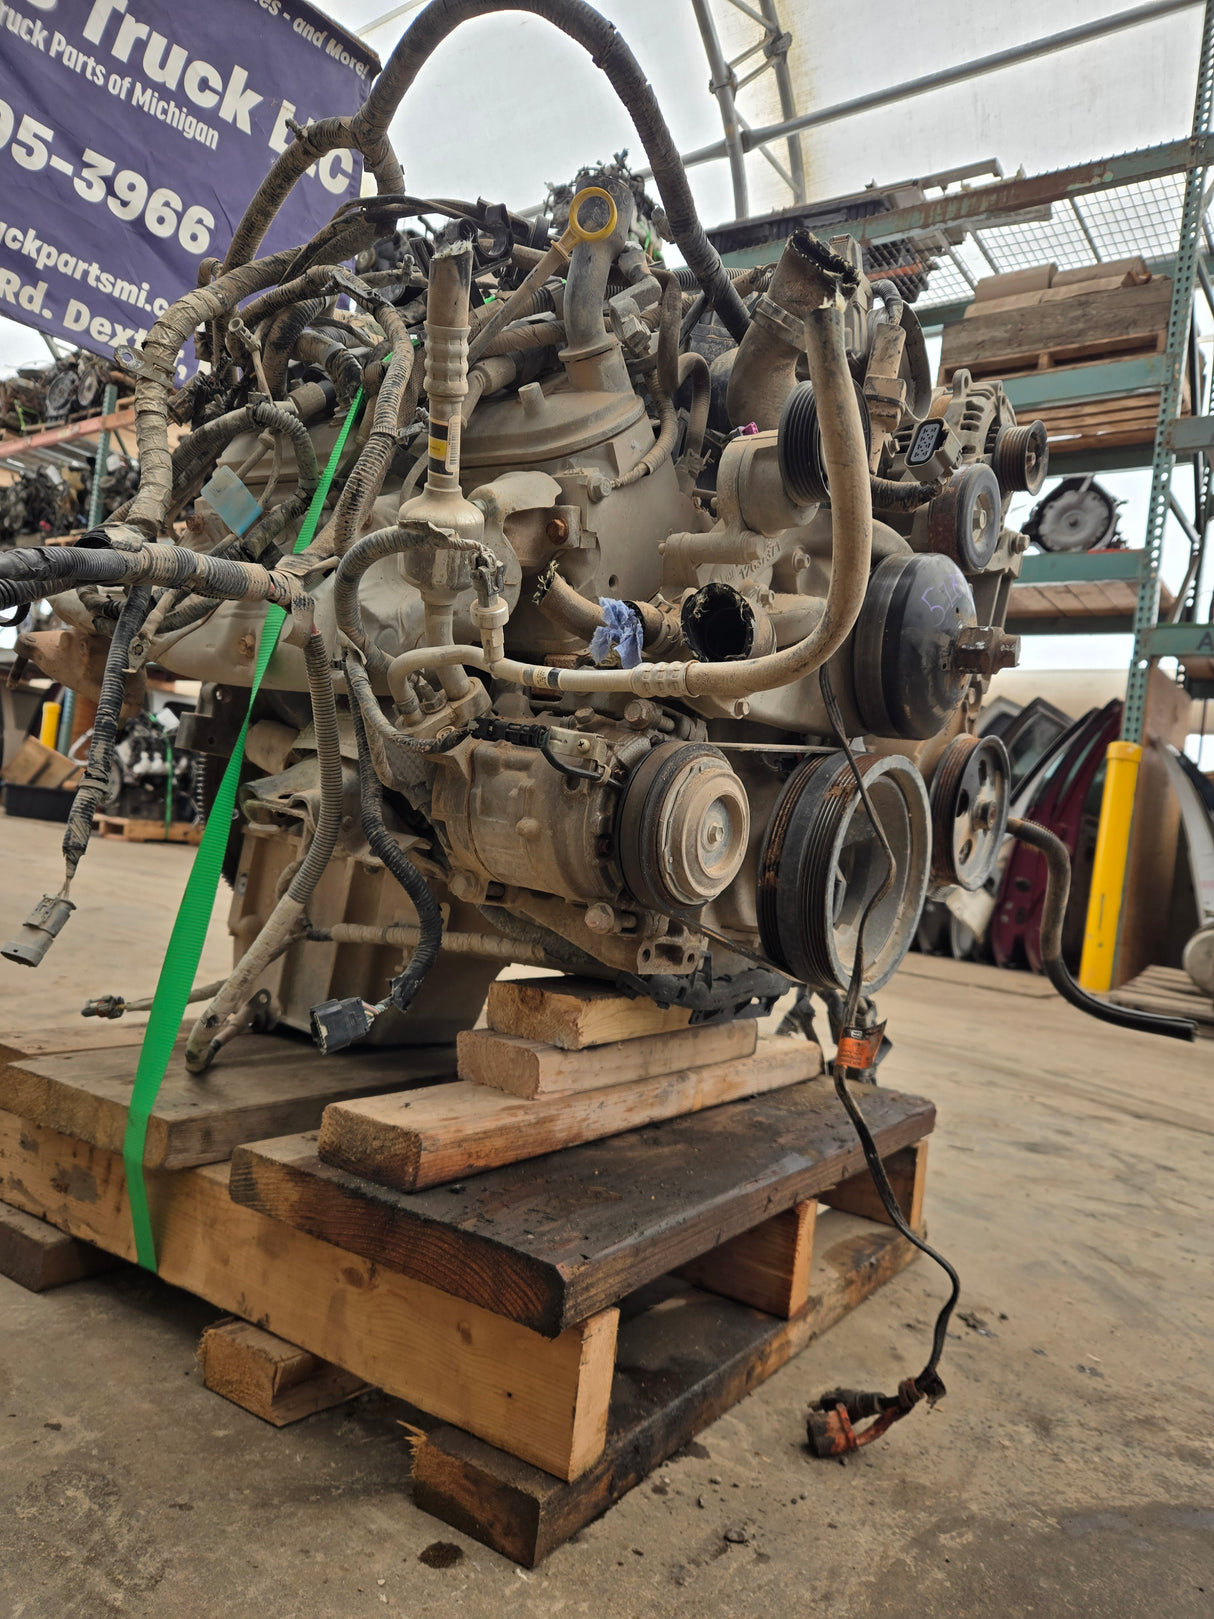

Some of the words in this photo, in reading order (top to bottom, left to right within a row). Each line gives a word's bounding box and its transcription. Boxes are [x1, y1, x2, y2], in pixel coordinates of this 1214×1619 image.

[49, 30, 106, 86] Parts
[107, 73, 132, 100] of
[131, 81, 219, 151] Michigan
[293, 17, 328, 48] and
[325, 38, 370, 80] More!
[82, 0, 264, 135] Truck
[267, 98, 354, 195] LC
[0, 267, 53, 320] Rd.
